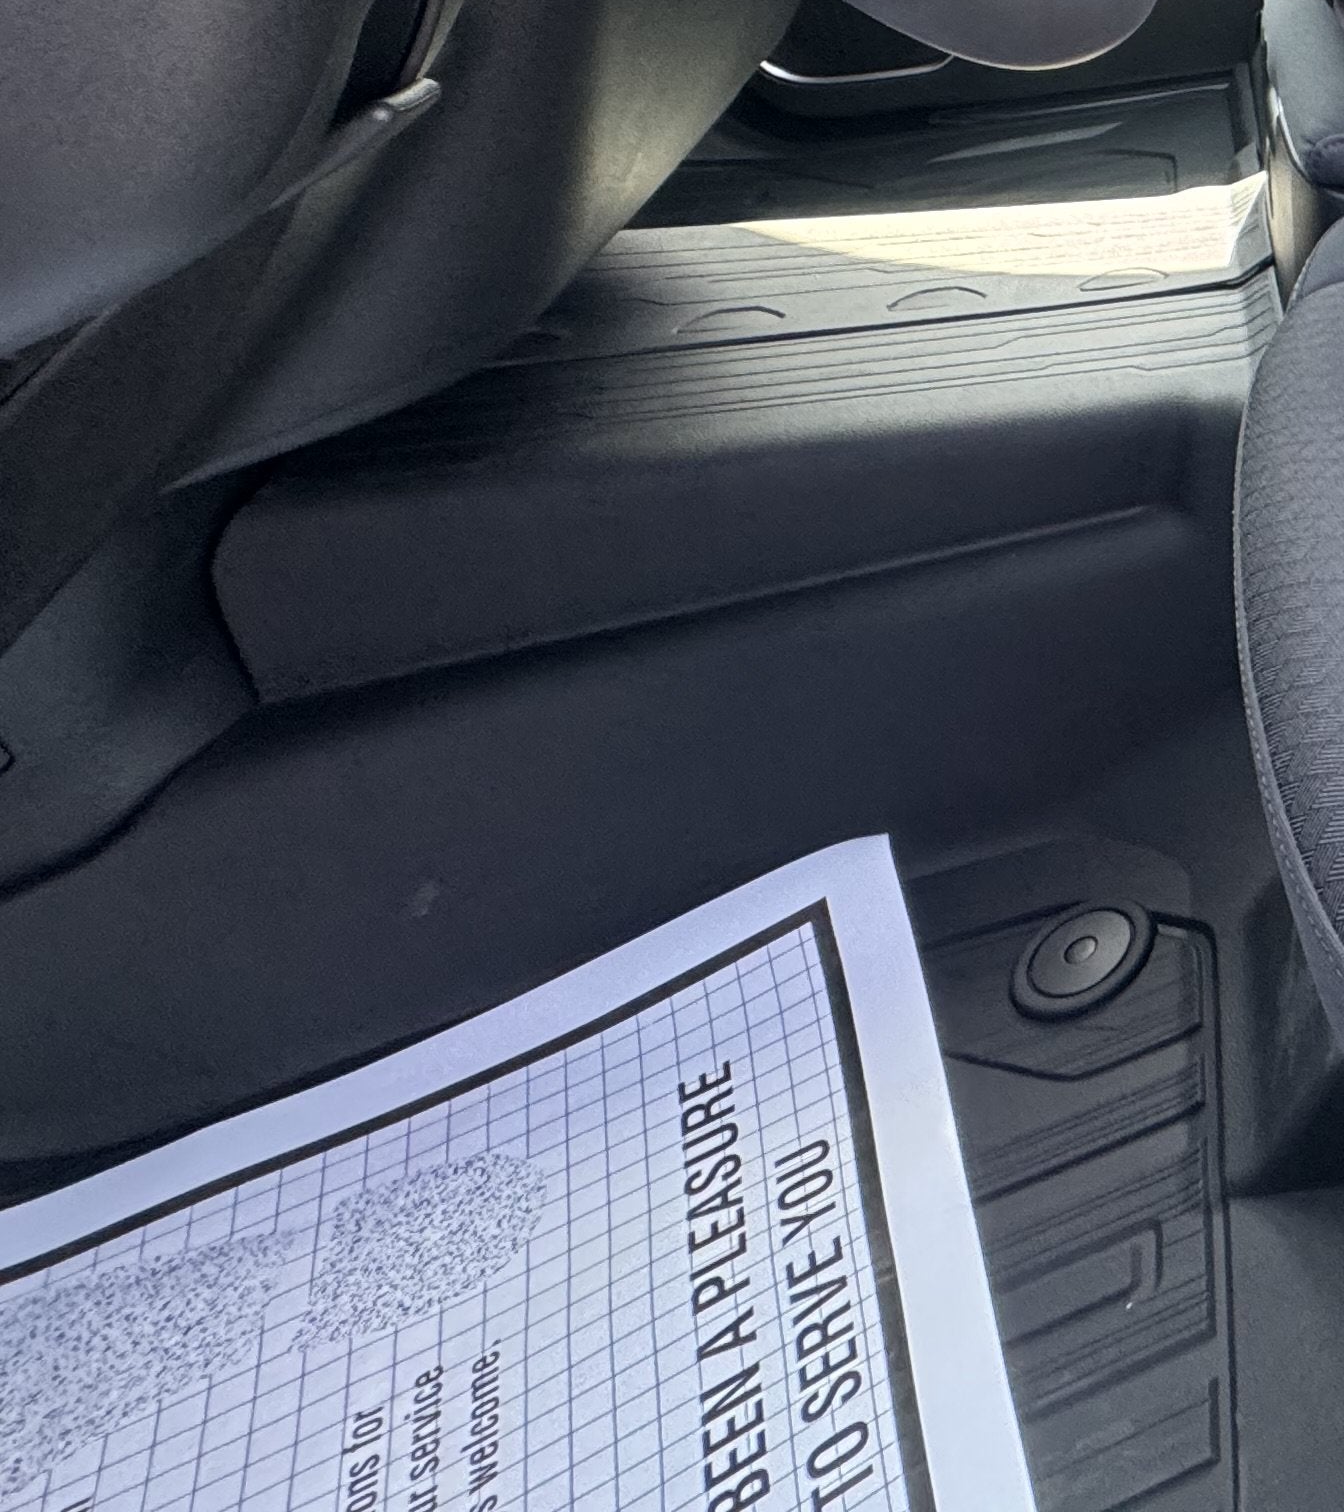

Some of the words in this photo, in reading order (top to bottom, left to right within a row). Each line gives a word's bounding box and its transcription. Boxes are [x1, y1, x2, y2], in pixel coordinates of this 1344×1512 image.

[677, 1059, 752, 1318] PLEASURE
[773, 1138, 837, 1248] YOU
[695, 1305, 759, 1365] A
[784, 1235, 864, 1424] SERVE
[341, 1406, 384, 1455] for
[403, 1364, 444, 1481] service
[460, 1339, 501, 1496] welcome.
[700, 1360, 771, 1512] BEEN
[806, 1420, 874, 1512] TO
